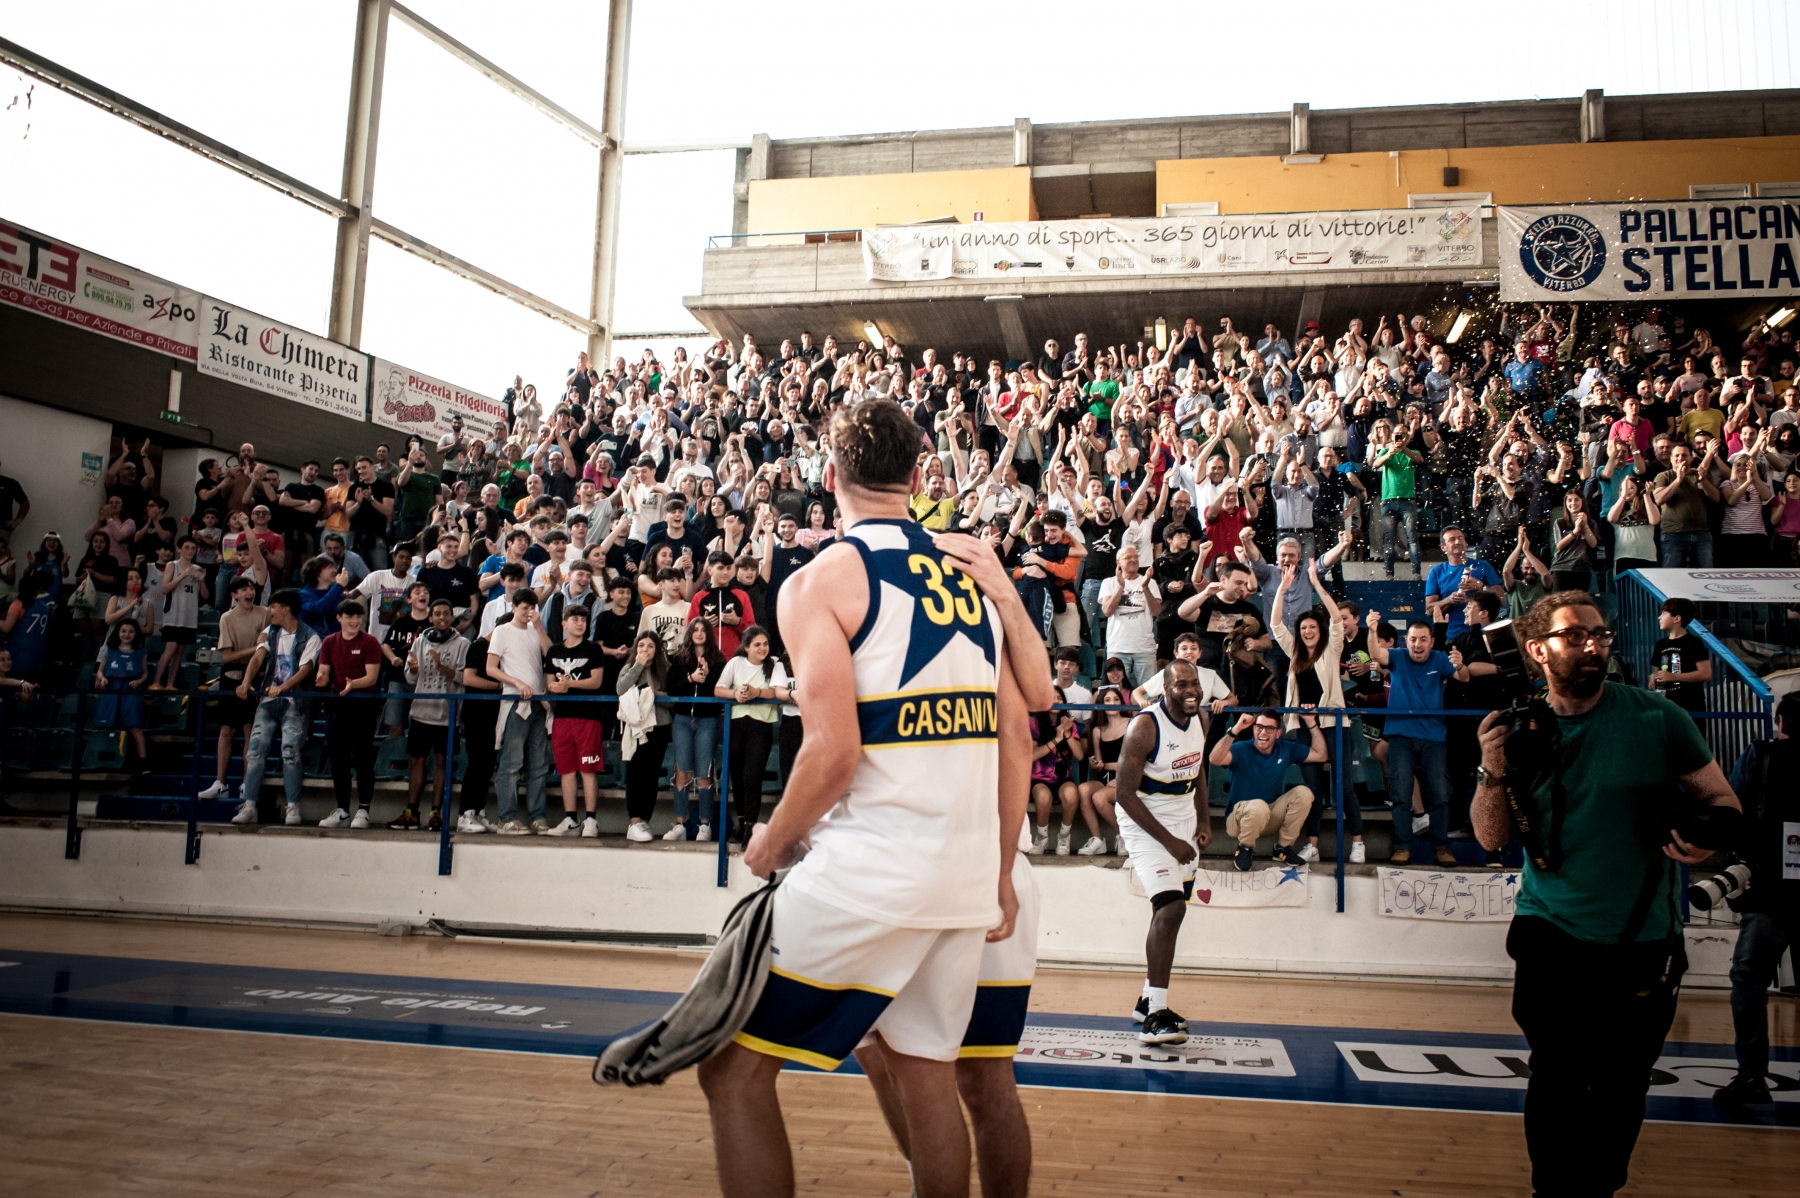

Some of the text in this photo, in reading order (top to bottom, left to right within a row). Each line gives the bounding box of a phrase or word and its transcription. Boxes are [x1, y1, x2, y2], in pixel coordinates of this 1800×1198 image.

[960, 231, 1019, 247] anno
[1027, 225, 1051, 245] di
[1143, 224, 1196, 243] 365
[1202, 219, 1279, 248] giorni
[1287, 217, 1312, 239] di
[1620, 204, 1800, 243] PALLACAN
[1437, 244, 1475, 252] VITERBO
[1623, 242, 1800, 293] STELLA
[22, 295, 32, 305] e
[35, 298, 63, 316] Gas
[66, 309, 90, 324] per
[91, 317, 142, 341] Aziende
[145, 335, 154, 345] e
[156, 337, 192, 356] Privati
[211, 305, 359, 384] La Chimera
[207, 342, 358, 406] Ristorante Pizzeria
[408, 374, 507, 418] Pizzeria Friggitoria
[183, 584, 194, 594] 31
[907, 553, 982, 626] 33
[26, 613, 48, 635] 79
[581, 754, 600, 765] FILA
[1505, 787, 1519, 810] Nikon
[1204, 869, 1278, 893] VITERBO
[1382, 877, 1461, 911] FORZA
[243, 988, 381, 1005] Auto
